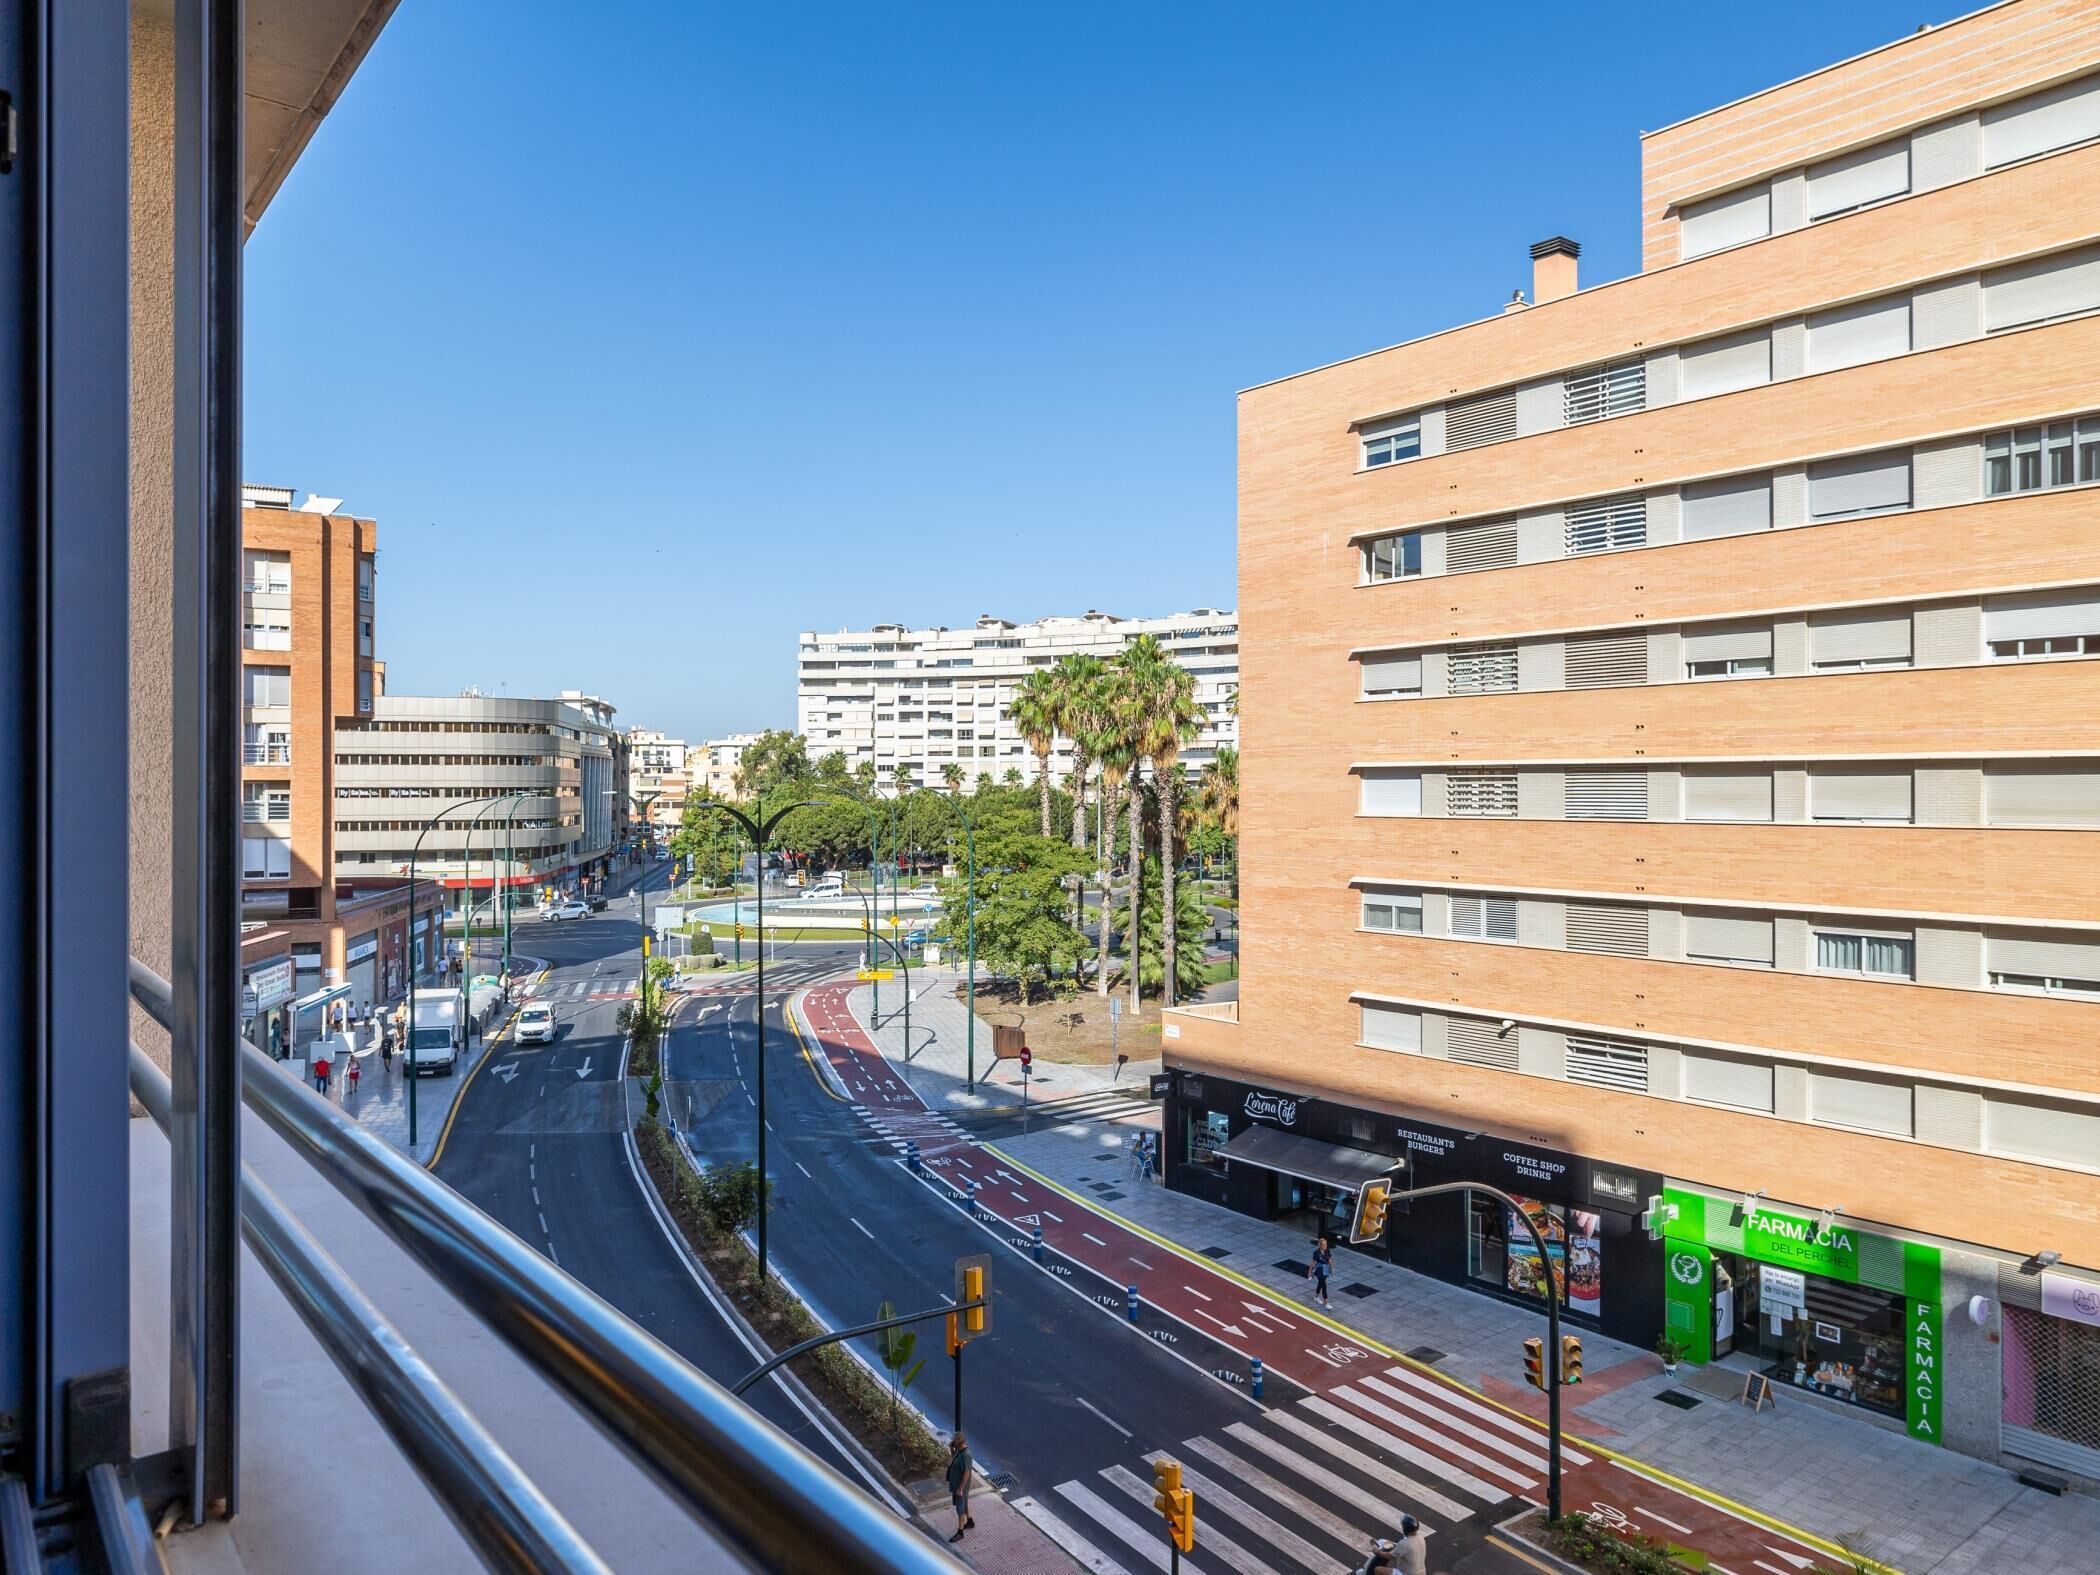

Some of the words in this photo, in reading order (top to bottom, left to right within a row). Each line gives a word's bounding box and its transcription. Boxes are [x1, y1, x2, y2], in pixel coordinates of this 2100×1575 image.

[1244, 1092, 1277, 1114] Lorena
[1277, 1099, 1297, 1126] Café
[1397, 1129, 1455, 1149] RESTAURANTS
[1407, 1140, 1445, 1156] BURGERS
[1503, 1152, 1538, 1168] COFFEE
[1540, 1160, 1566, 1174] SHOP
[1517, 1165, 1551, 1181] DRINKS
[1748, 1214, 1853, 1252] FARMACIA
[1771, 1241, 1794, 1256] DEL
[1796, 1247, 1854, 1269] PERCHEL
[1916, 1304, 1933, 1434] FARMACIA
